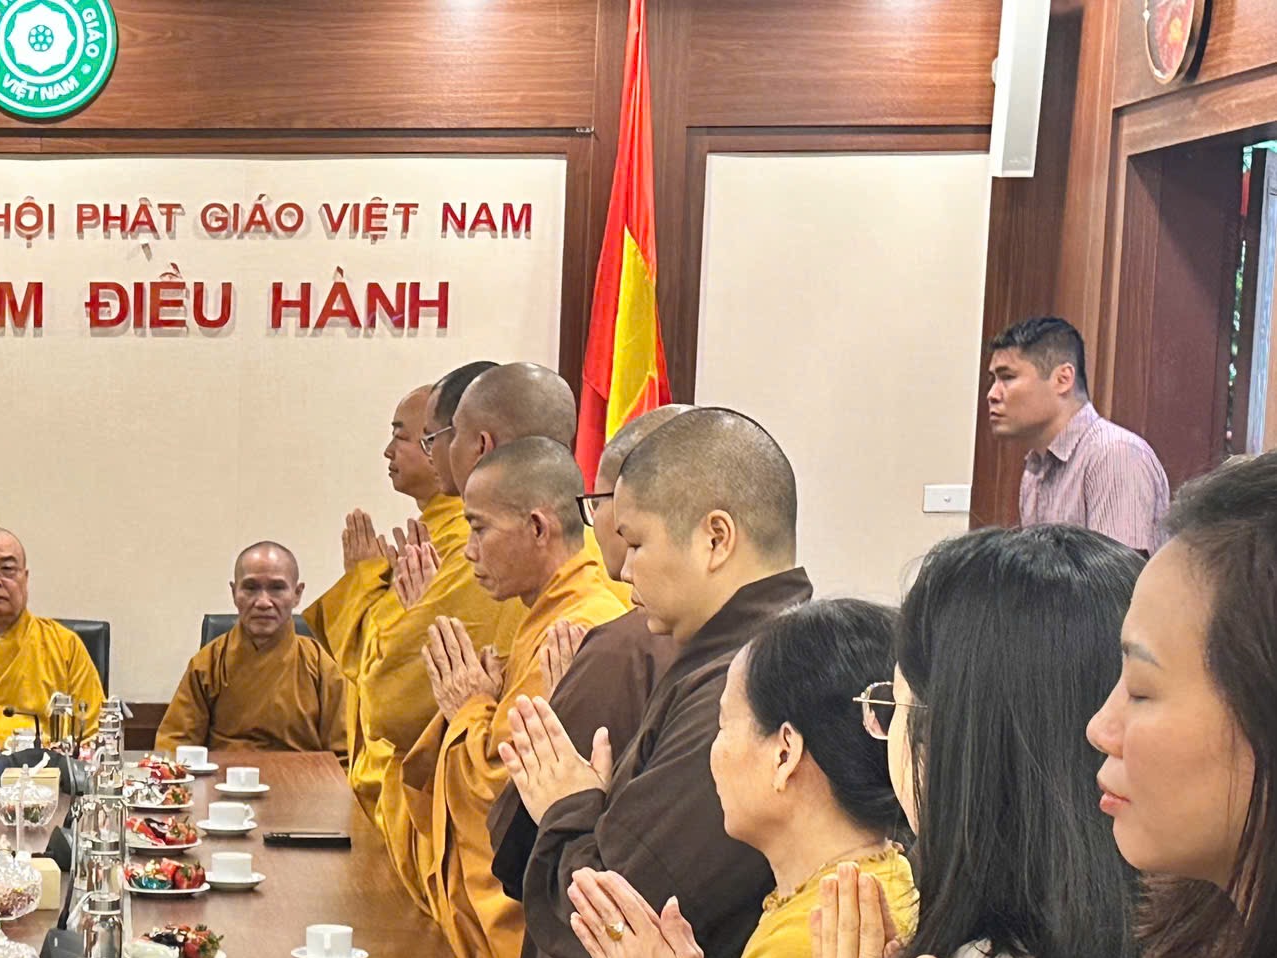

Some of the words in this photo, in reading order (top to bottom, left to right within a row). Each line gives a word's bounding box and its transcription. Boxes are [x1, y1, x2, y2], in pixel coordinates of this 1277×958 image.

[40, 75, 80, 100] NAM
[76, 196, 184, 250] PHẬT
[200, 193, 304, 233] GIÁO
[320, 196, 419, 243] VIỆT
[442, 202, 532, 233] NAM
[85, 262, 232, 329] ĐIỀU
[271, 266, 449, 329] HÀNH
